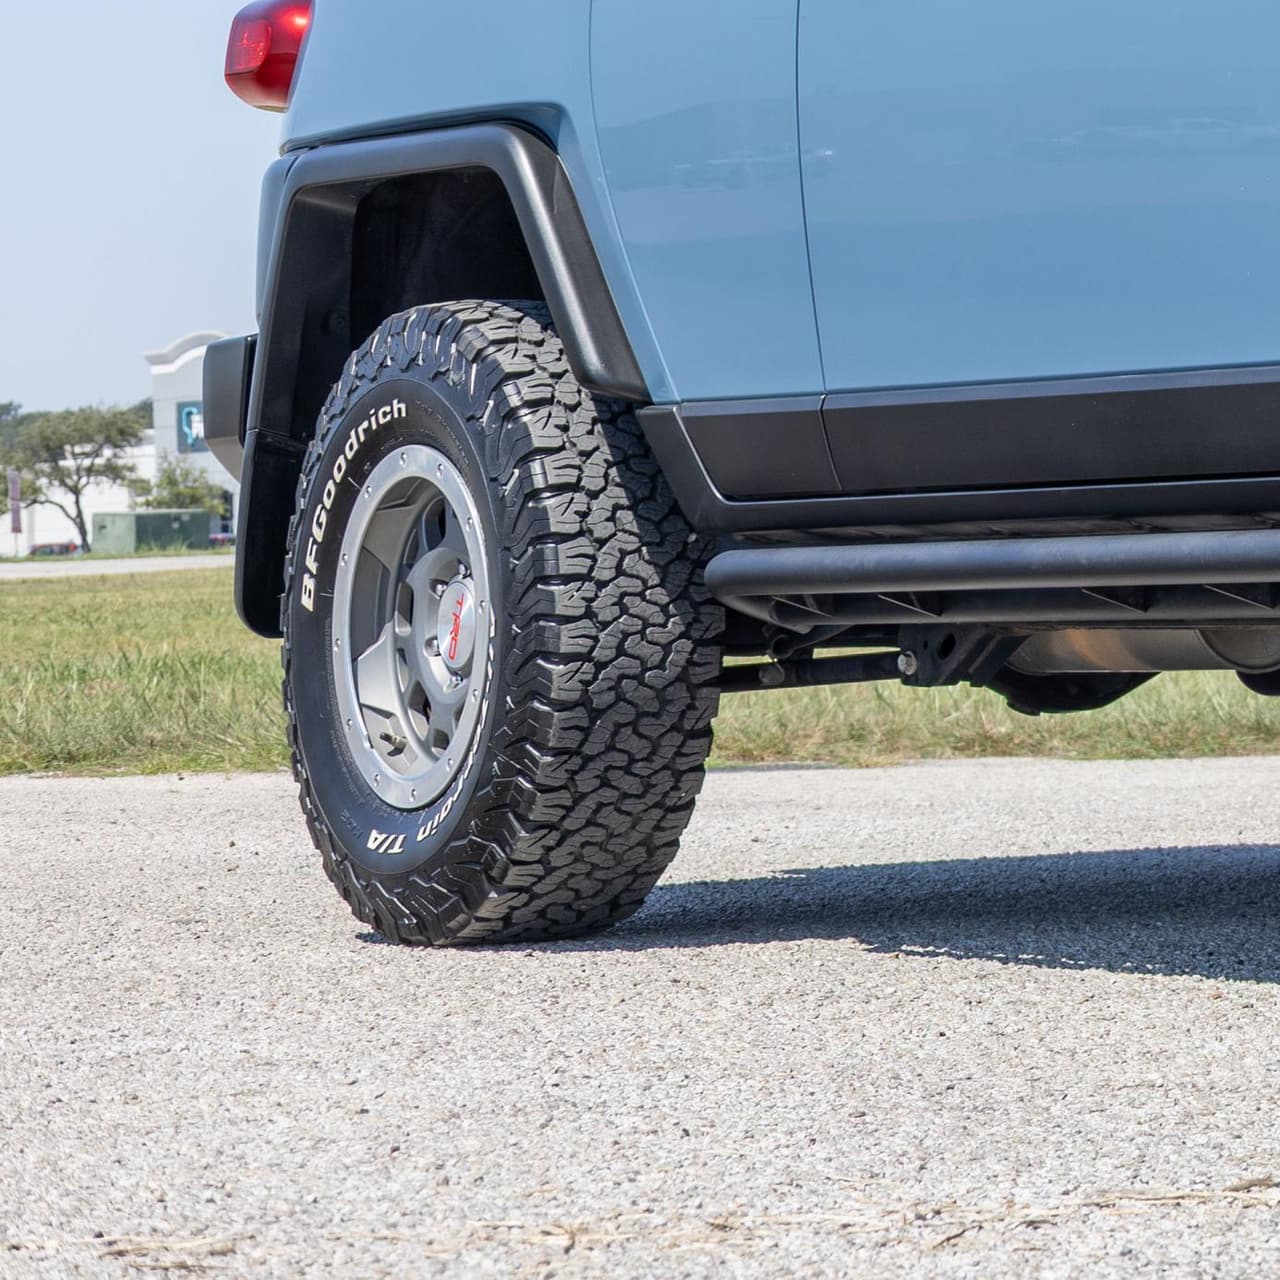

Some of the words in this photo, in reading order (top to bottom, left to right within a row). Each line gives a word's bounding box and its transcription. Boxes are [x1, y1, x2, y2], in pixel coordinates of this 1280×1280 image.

[301, 398, 407, 613] BFGoodrich
[447, 592, 465, 660] TRD
[366, 828, 407, 855] T/A
